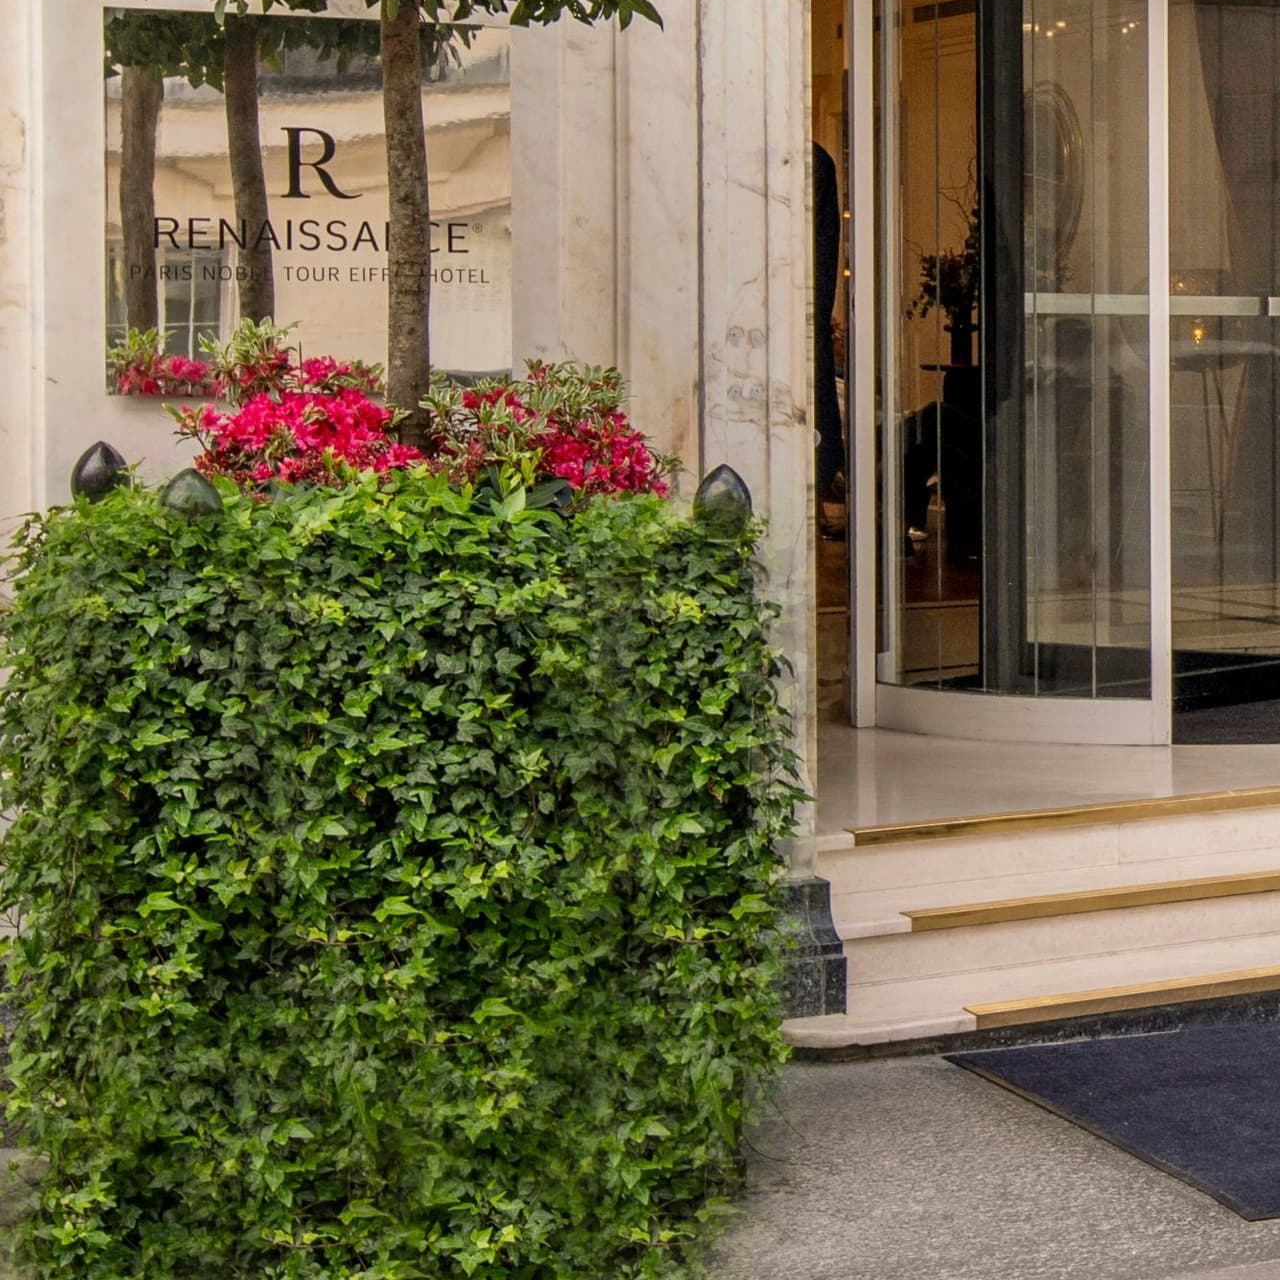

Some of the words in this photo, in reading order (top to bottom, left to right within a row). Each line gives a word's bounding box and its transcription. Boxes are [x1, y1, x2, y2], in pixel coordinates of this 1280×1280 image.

[281, 126, 362, 199] R
[130, 264, 193, 282] PARIS
[283, 265, 340, 282] TOUR
